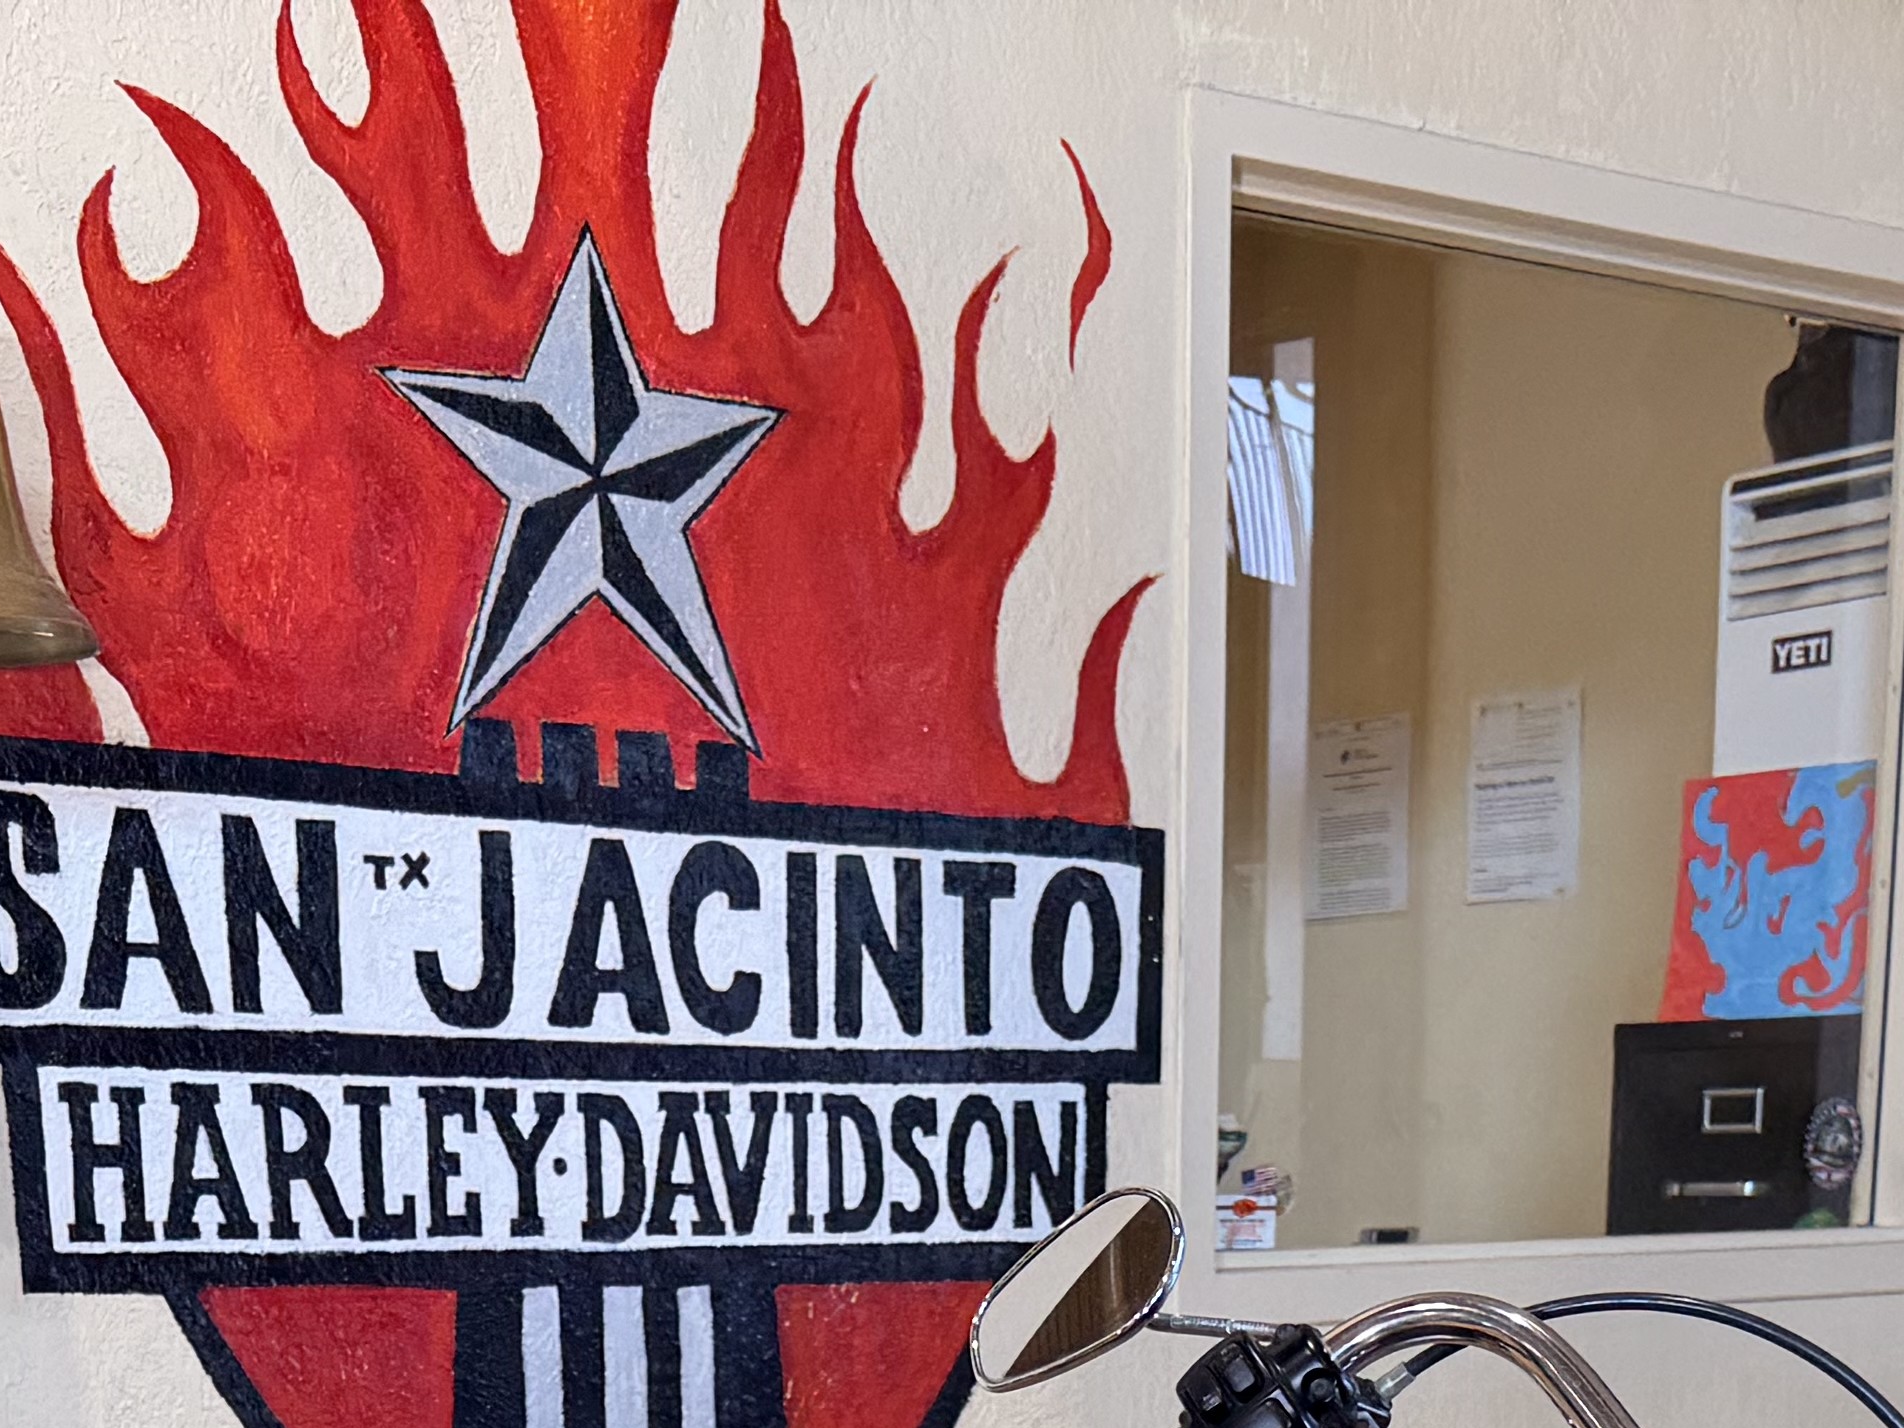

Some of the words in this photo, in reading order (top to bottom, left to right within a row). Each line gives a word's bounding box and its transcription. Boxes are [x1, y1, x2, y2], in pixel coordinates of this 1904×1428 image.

[1775, 635, 1828, 668] YETI
[362, 849, 430, 890] TX
[414, 829, 1121, 1041] JACINTO
